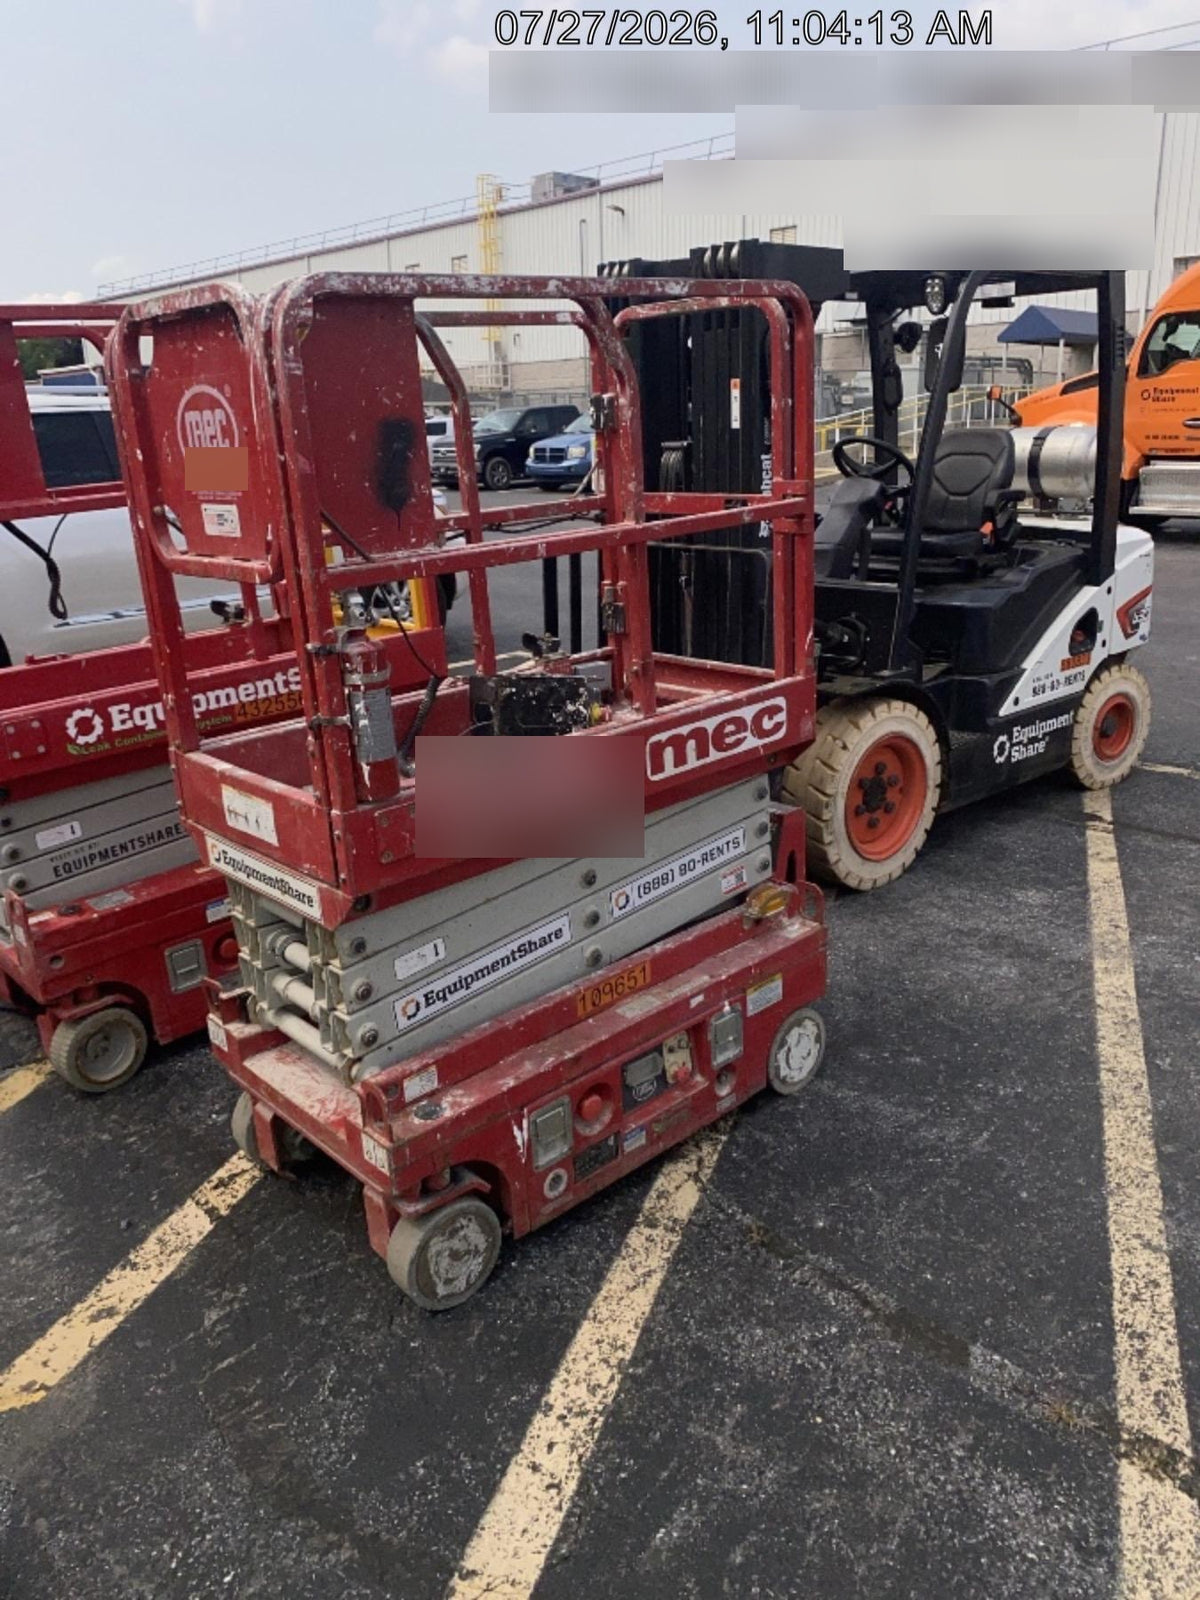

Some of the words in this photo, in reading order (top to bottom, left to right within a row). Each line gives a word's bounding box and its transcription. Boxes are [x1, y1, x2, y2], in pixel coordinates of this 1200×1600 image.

[648, 703, 785, 777] mec
[1010, 740, 1047, 763] Share
[1011, 709, 1075, 743] Equipment
[222, 849, 315, 908] EquipmentShare
[637, 868, 675, 899] (888)
[678, 836, 741, 877] 80-RENTS
[422, 927, 565, 1009] EquipmentShare
[578, 964, 647, 1012] 109651
